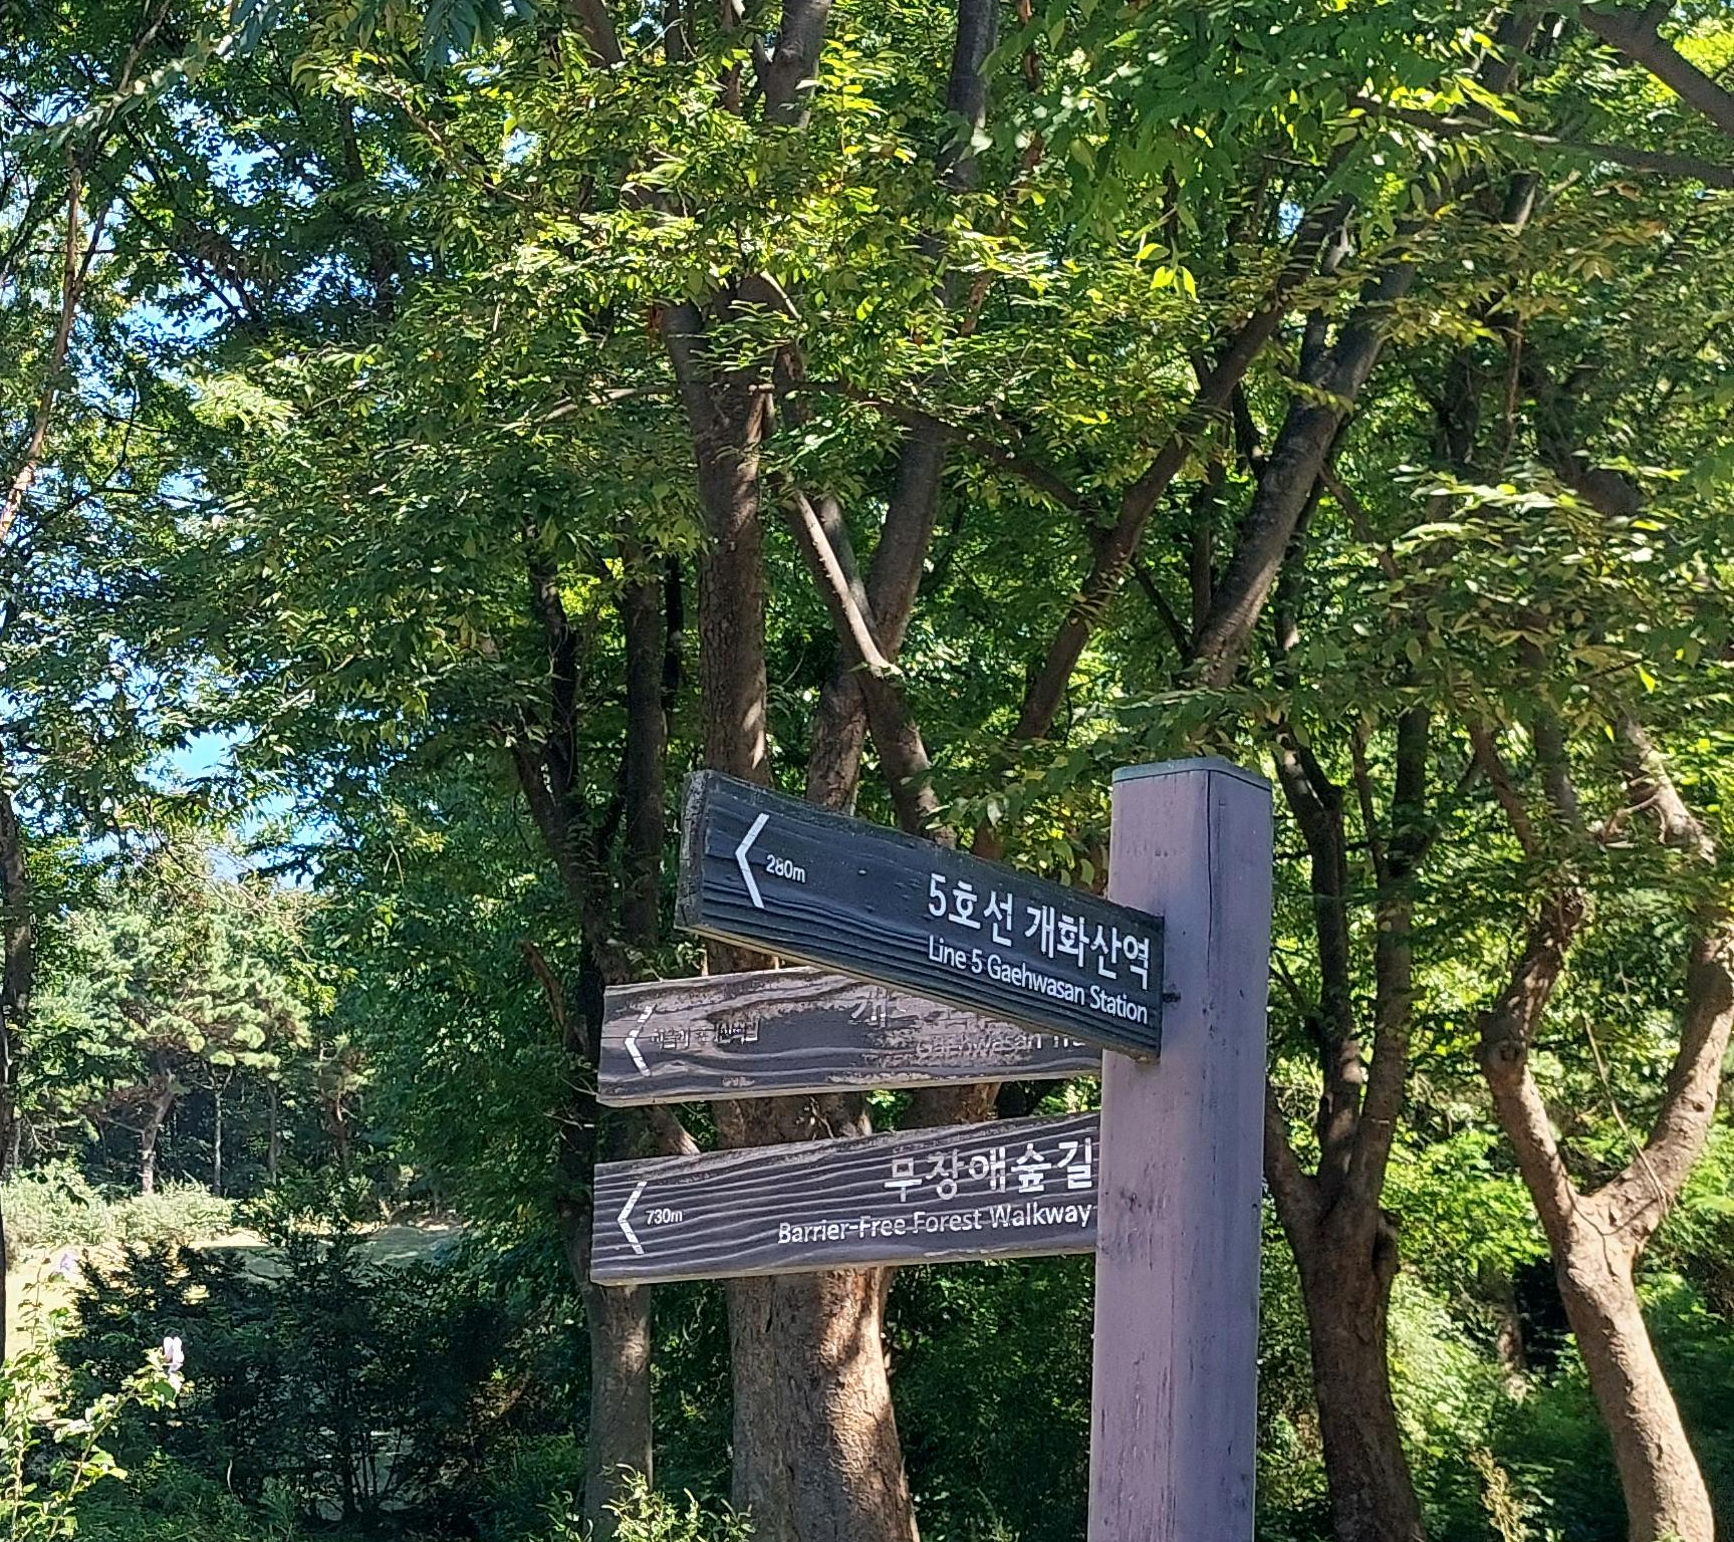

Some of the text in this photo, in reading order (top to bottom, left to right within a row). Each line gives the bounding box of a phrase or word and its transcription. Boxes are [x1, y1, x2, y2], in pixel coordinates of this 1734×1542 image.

[766, 854, 806, 883] 280m
[928, 873, 1149, 990] 5호선 개화산역
[928, 935, 1148, 1024] Line 5 Gaehwasan Station
[884, 1137, 1093, 1202] 무장애숲길
[646, 1208, 683, 1225] 730m
[778, 1202, 1093, 1244] Barrier-Free Forest Walkway
